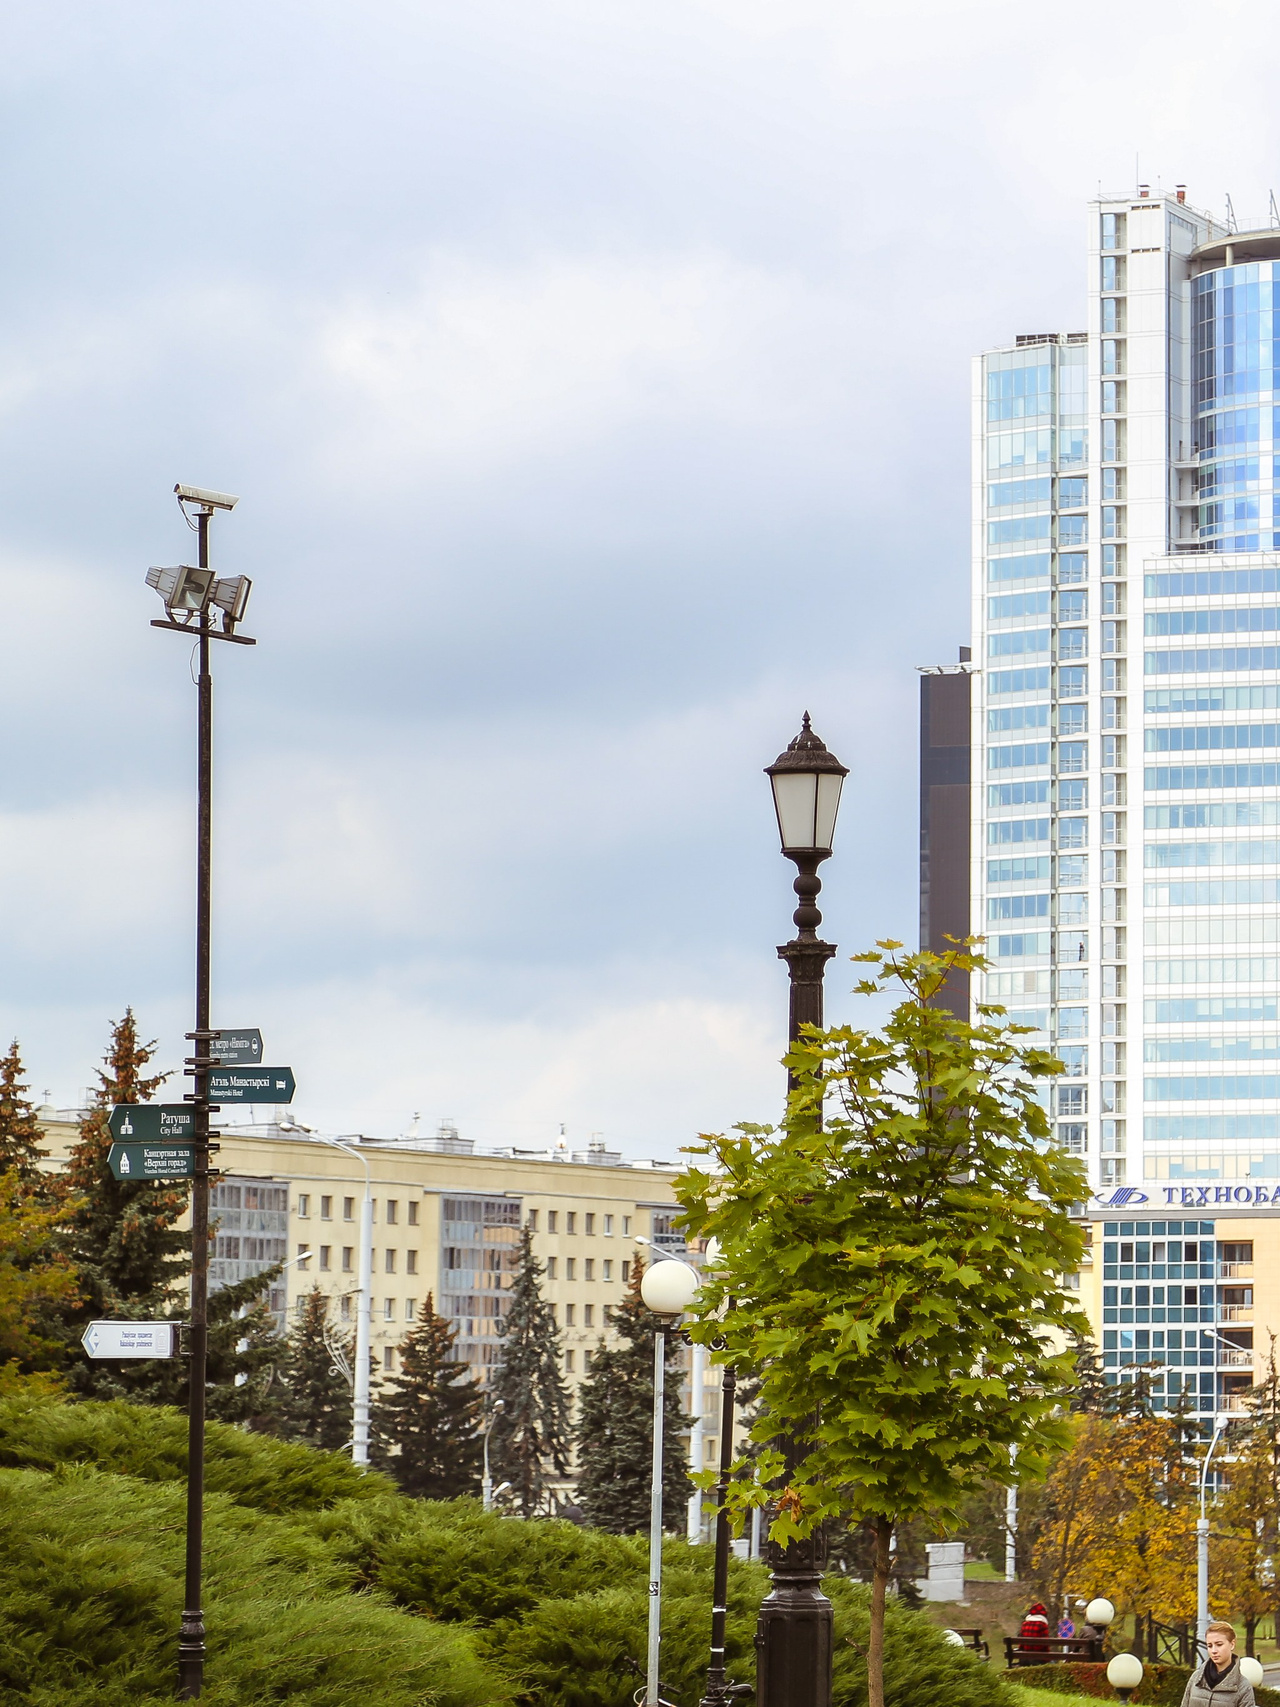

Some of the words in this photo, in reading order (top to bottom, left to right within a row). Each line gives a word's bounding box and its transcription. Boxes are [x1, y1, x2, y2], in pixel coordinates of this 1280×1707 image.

[160, 1112, 190, 1126] Ратуша
[160, 1127, 171, 1136] City
[171, 1126, 182, 1134] Hall
